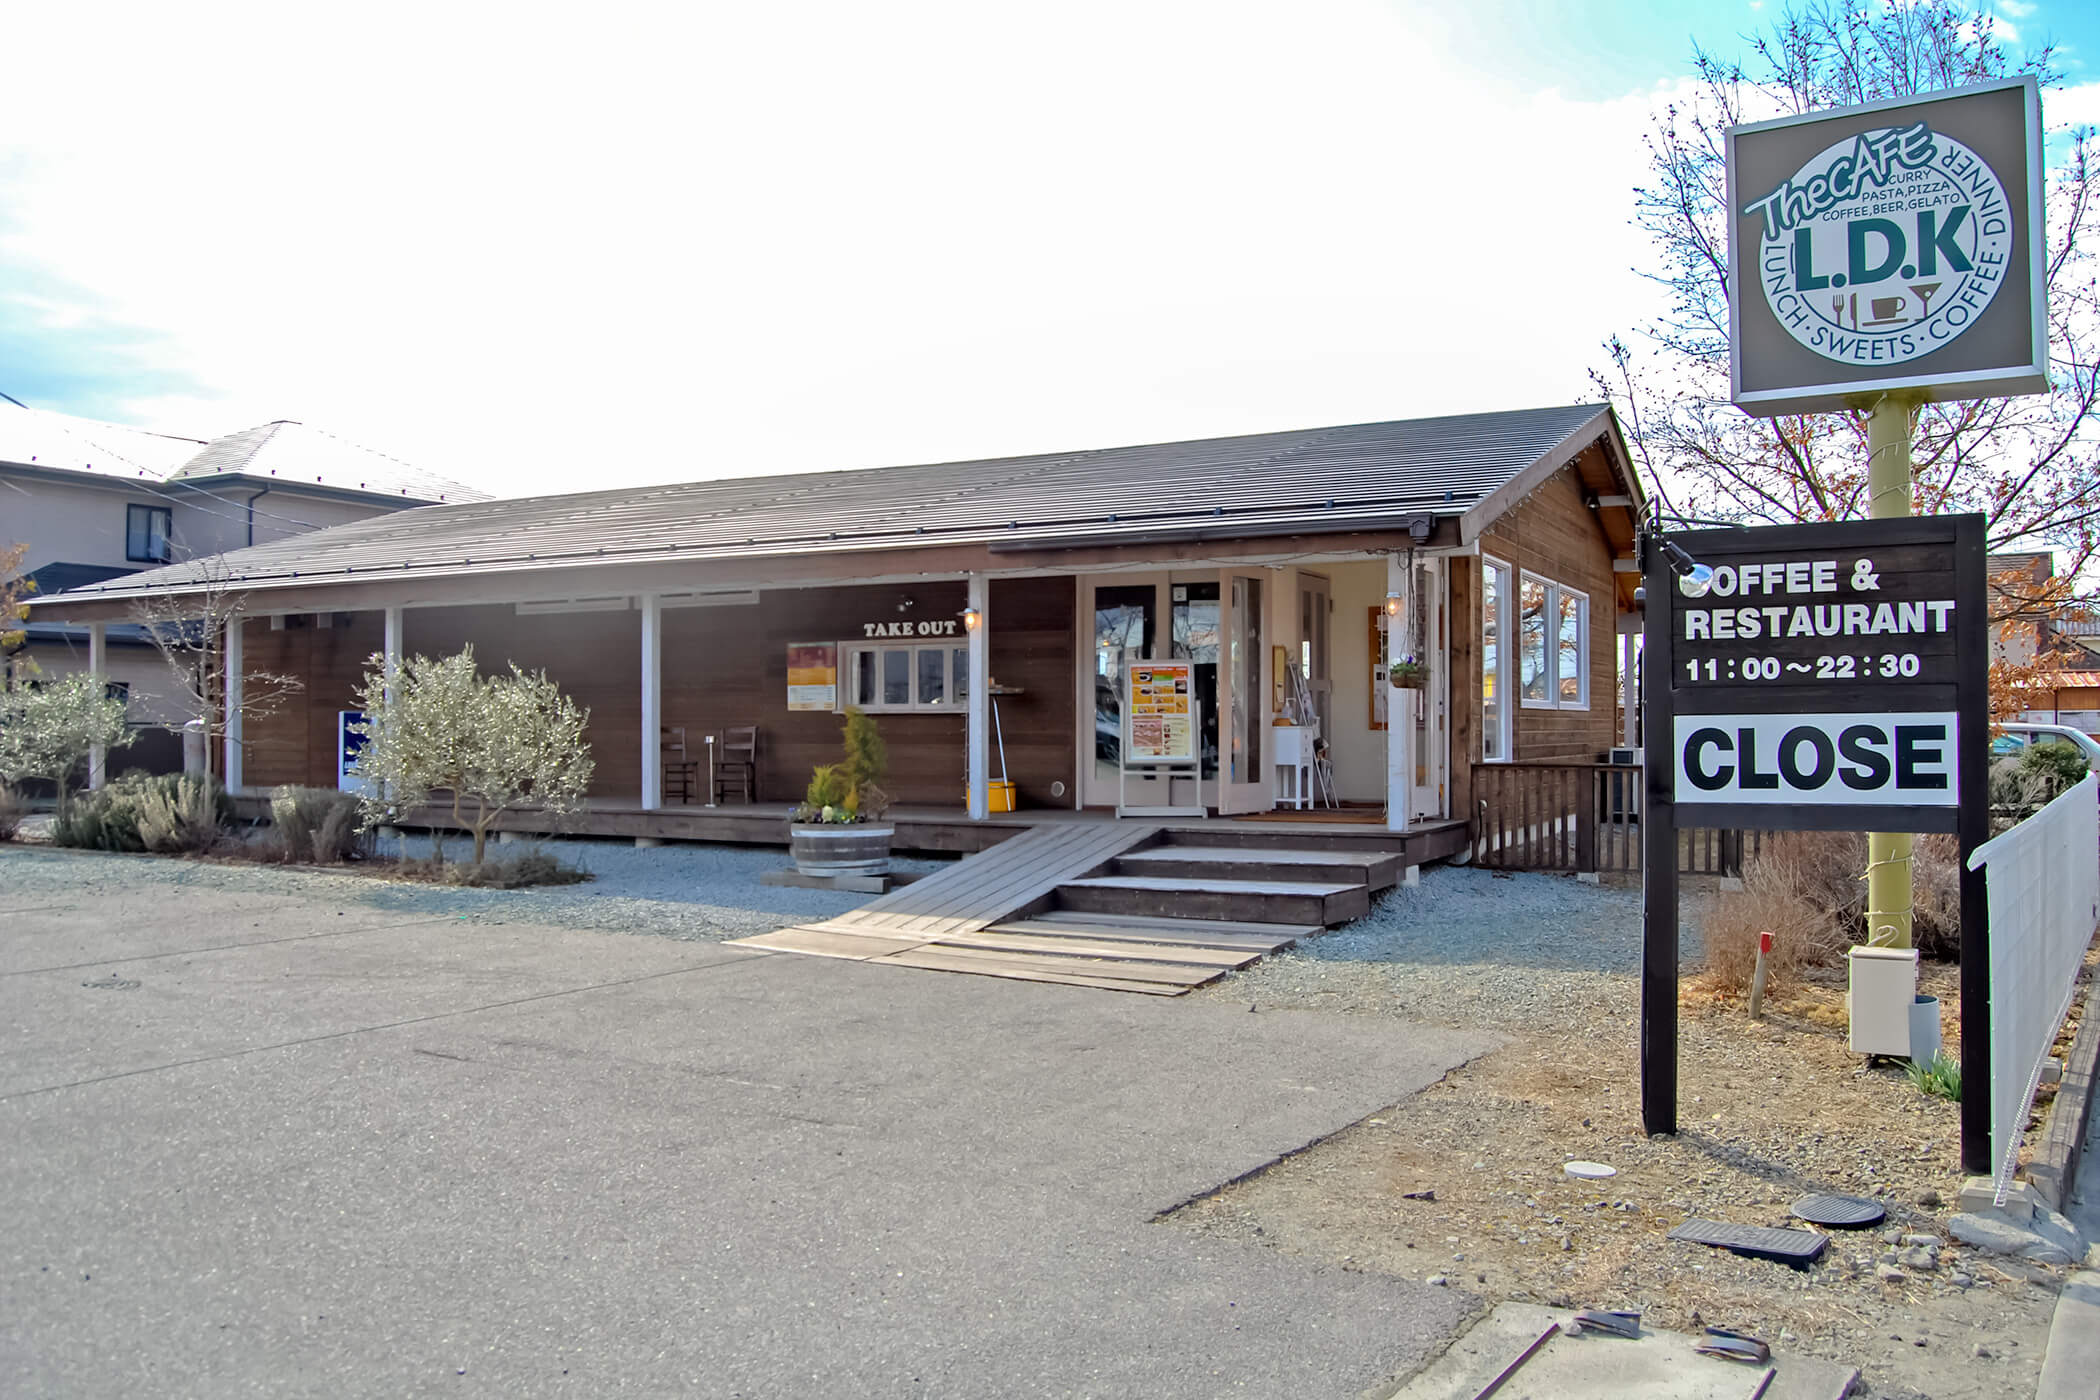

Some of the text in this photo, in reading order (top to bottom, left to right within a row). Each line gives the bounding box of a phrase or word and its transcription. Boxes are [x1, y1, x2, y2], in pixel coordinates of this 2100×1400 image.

[1888, 169, 1932, 186] CURRY
[1765, 145, 2006, 360] LUNCH SWEETS COFFEE DINNER
[1794, 204, 1975, 292] L.D.K
[1684, 559, 1880, 598] OFFEE &
[864, 620, 956, 637] TAKE OUT
[1685, 600, 1956, 641] RESTAURANT
[1683, 724, 1949, 791] CLOSE
